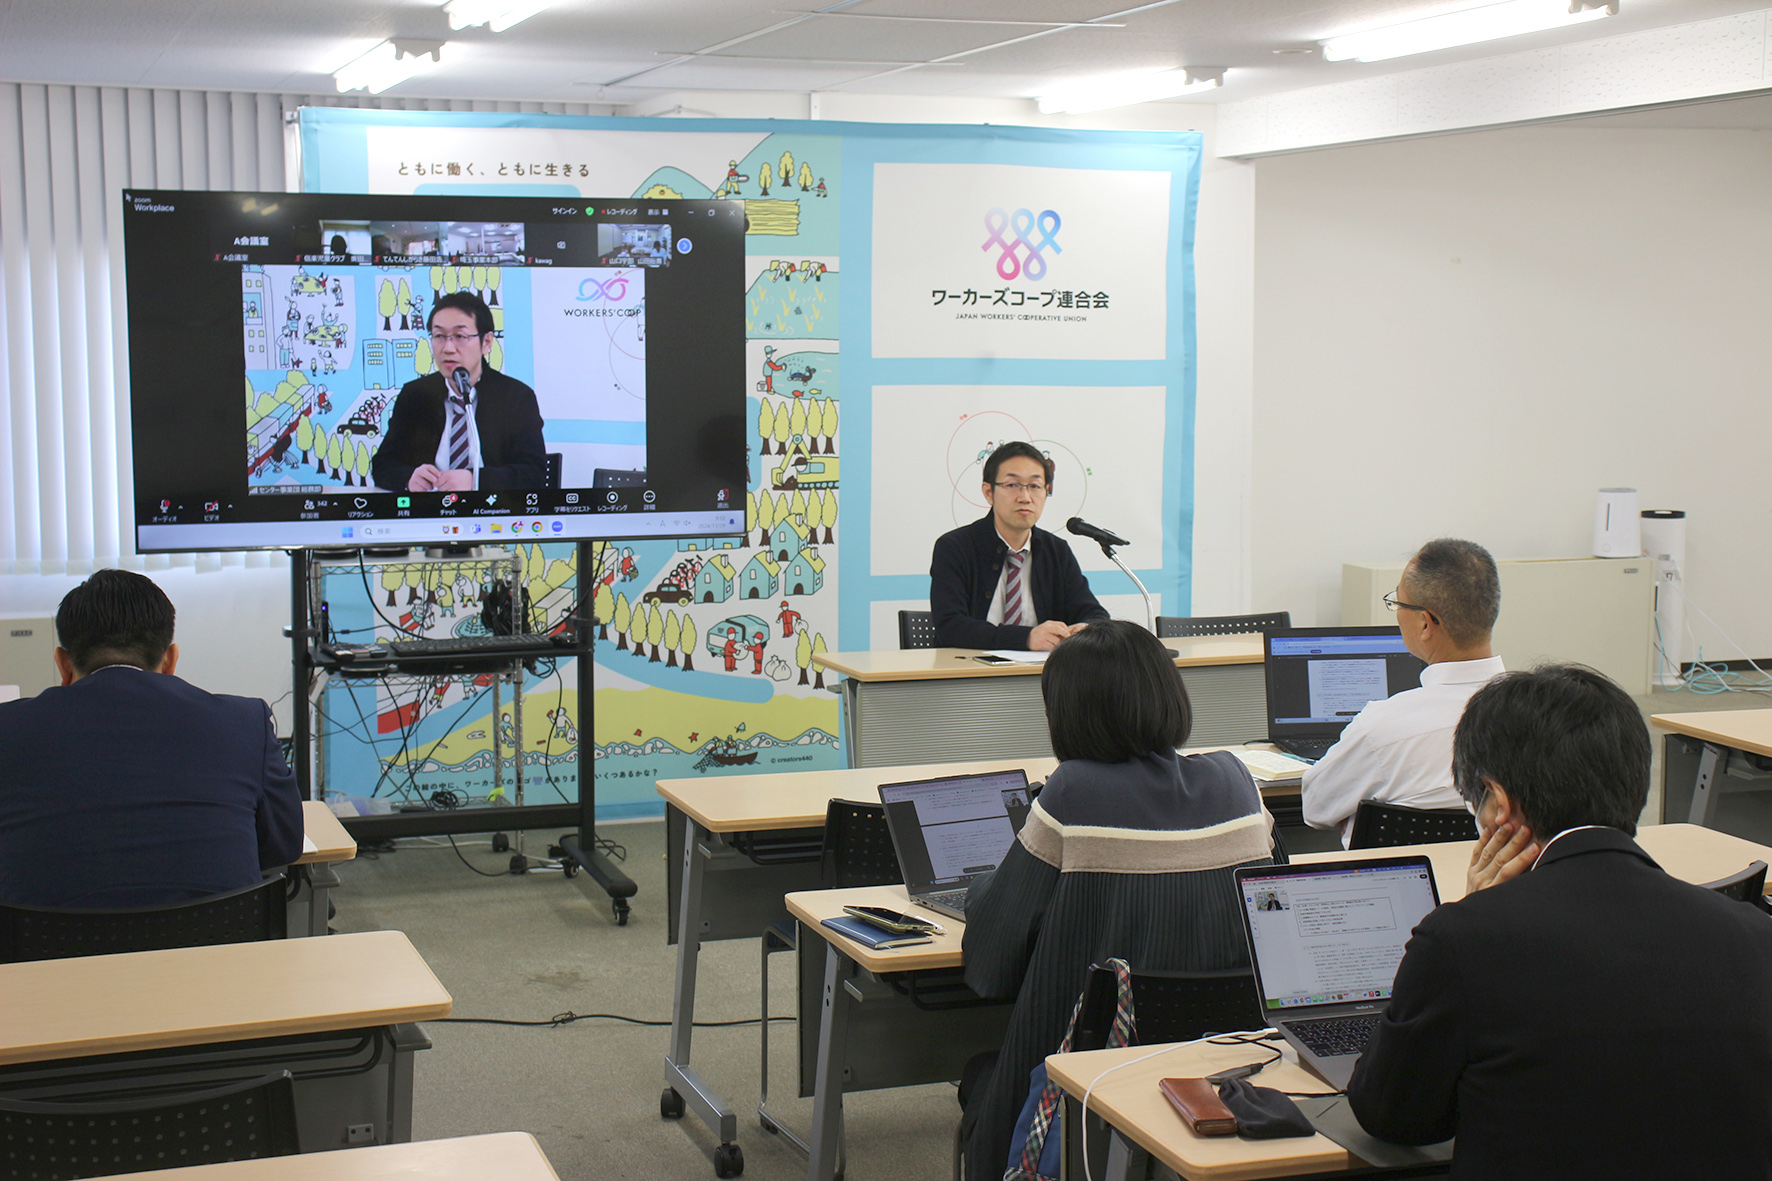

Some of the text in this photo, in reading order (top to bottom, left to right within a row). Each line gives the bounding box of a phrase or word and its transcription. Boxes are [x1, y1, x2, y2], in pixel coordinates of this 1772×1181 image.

[398, 162, 590, 177] ともに働く、ともに生きる
[134, 204, 175, 213] Workplace
[552, 207, 578, 215] サインイン
[606, 208, 638, 216] レコーディング
[233, 236, 270, 247] A会議室
[932, 287, 1110, 309] ワーカーズコープ連合会
[440, 508, 457, 516] チャット
[597, 504, 629, 512] レコーディング
[204, 513, 220, 521] ビデオ
